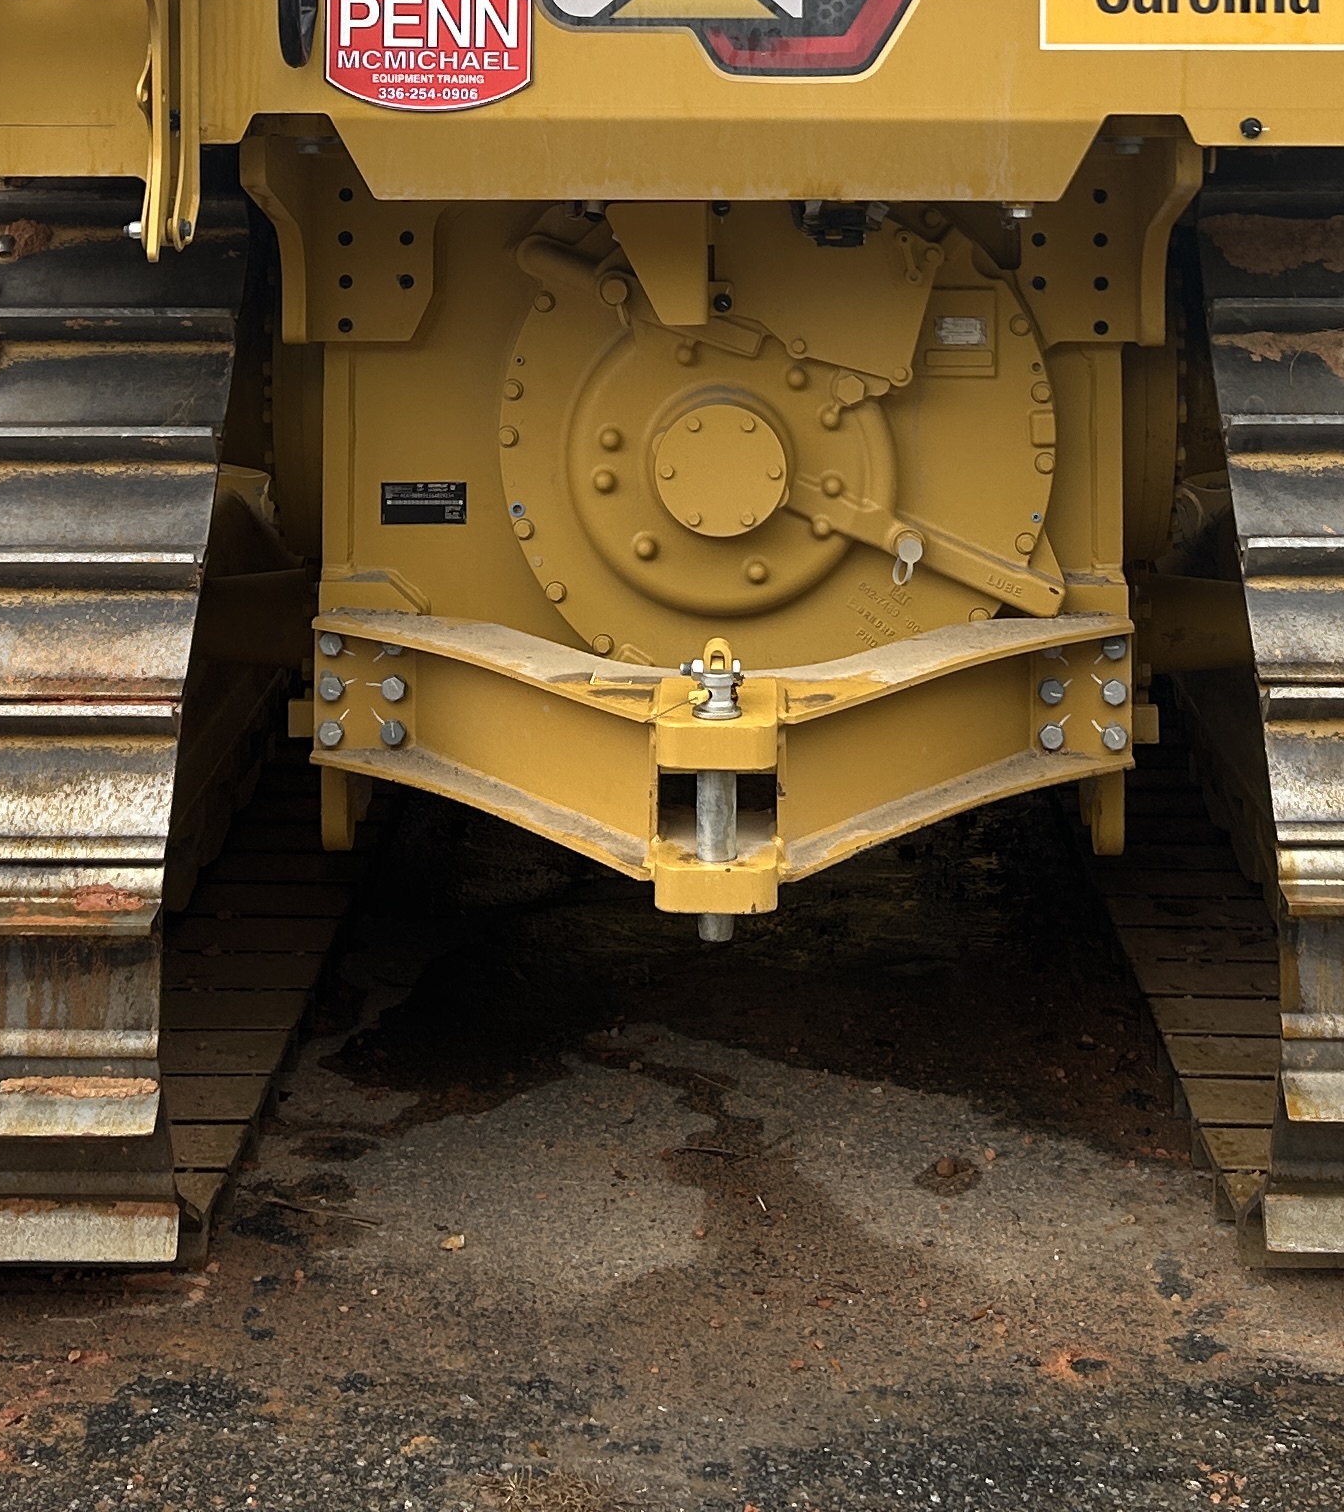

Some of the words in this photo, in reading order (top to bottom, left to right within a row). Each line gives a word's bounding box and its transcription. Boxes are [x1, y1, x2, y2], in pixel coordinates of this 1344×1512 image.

[337, 50, 520, 70] MCMICHAEL
[371, 73, 434, 84] EQUIPMENT
[436, 74, 485, 84] TRADING
[377, 87, 479, 100] 336-254-0906
[986, 574, 1024, 598] LUBE
